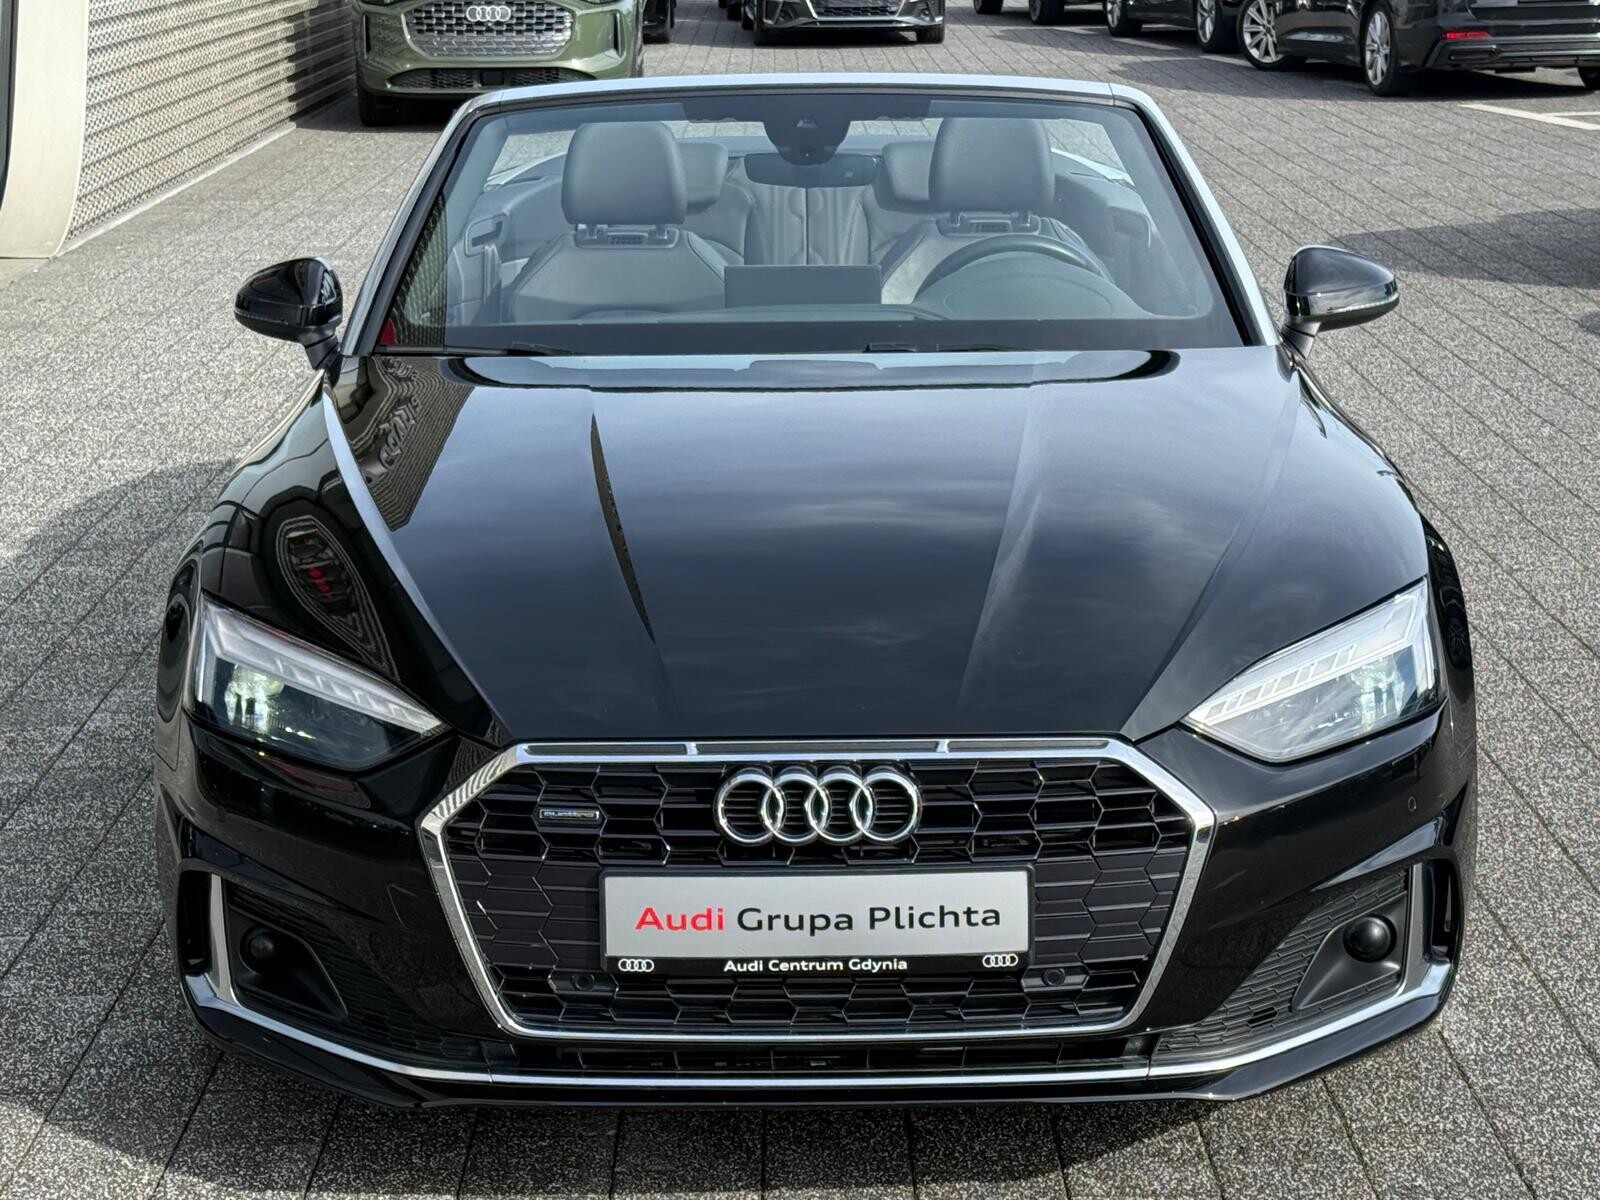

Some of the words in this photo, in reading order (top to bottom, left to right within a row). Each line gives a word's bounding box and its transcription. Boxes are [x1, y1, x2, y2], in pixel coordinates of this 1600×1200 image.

[635, 906, 725, 932] Audi
[737, 907, 854, 937] Grupa
[869, 904, 1001, 930] Plichta
[723, 958, 764, 972] Audi
[768, 958, 844, 972] Centrum
[849, 957, 908, 973] Gdynia
